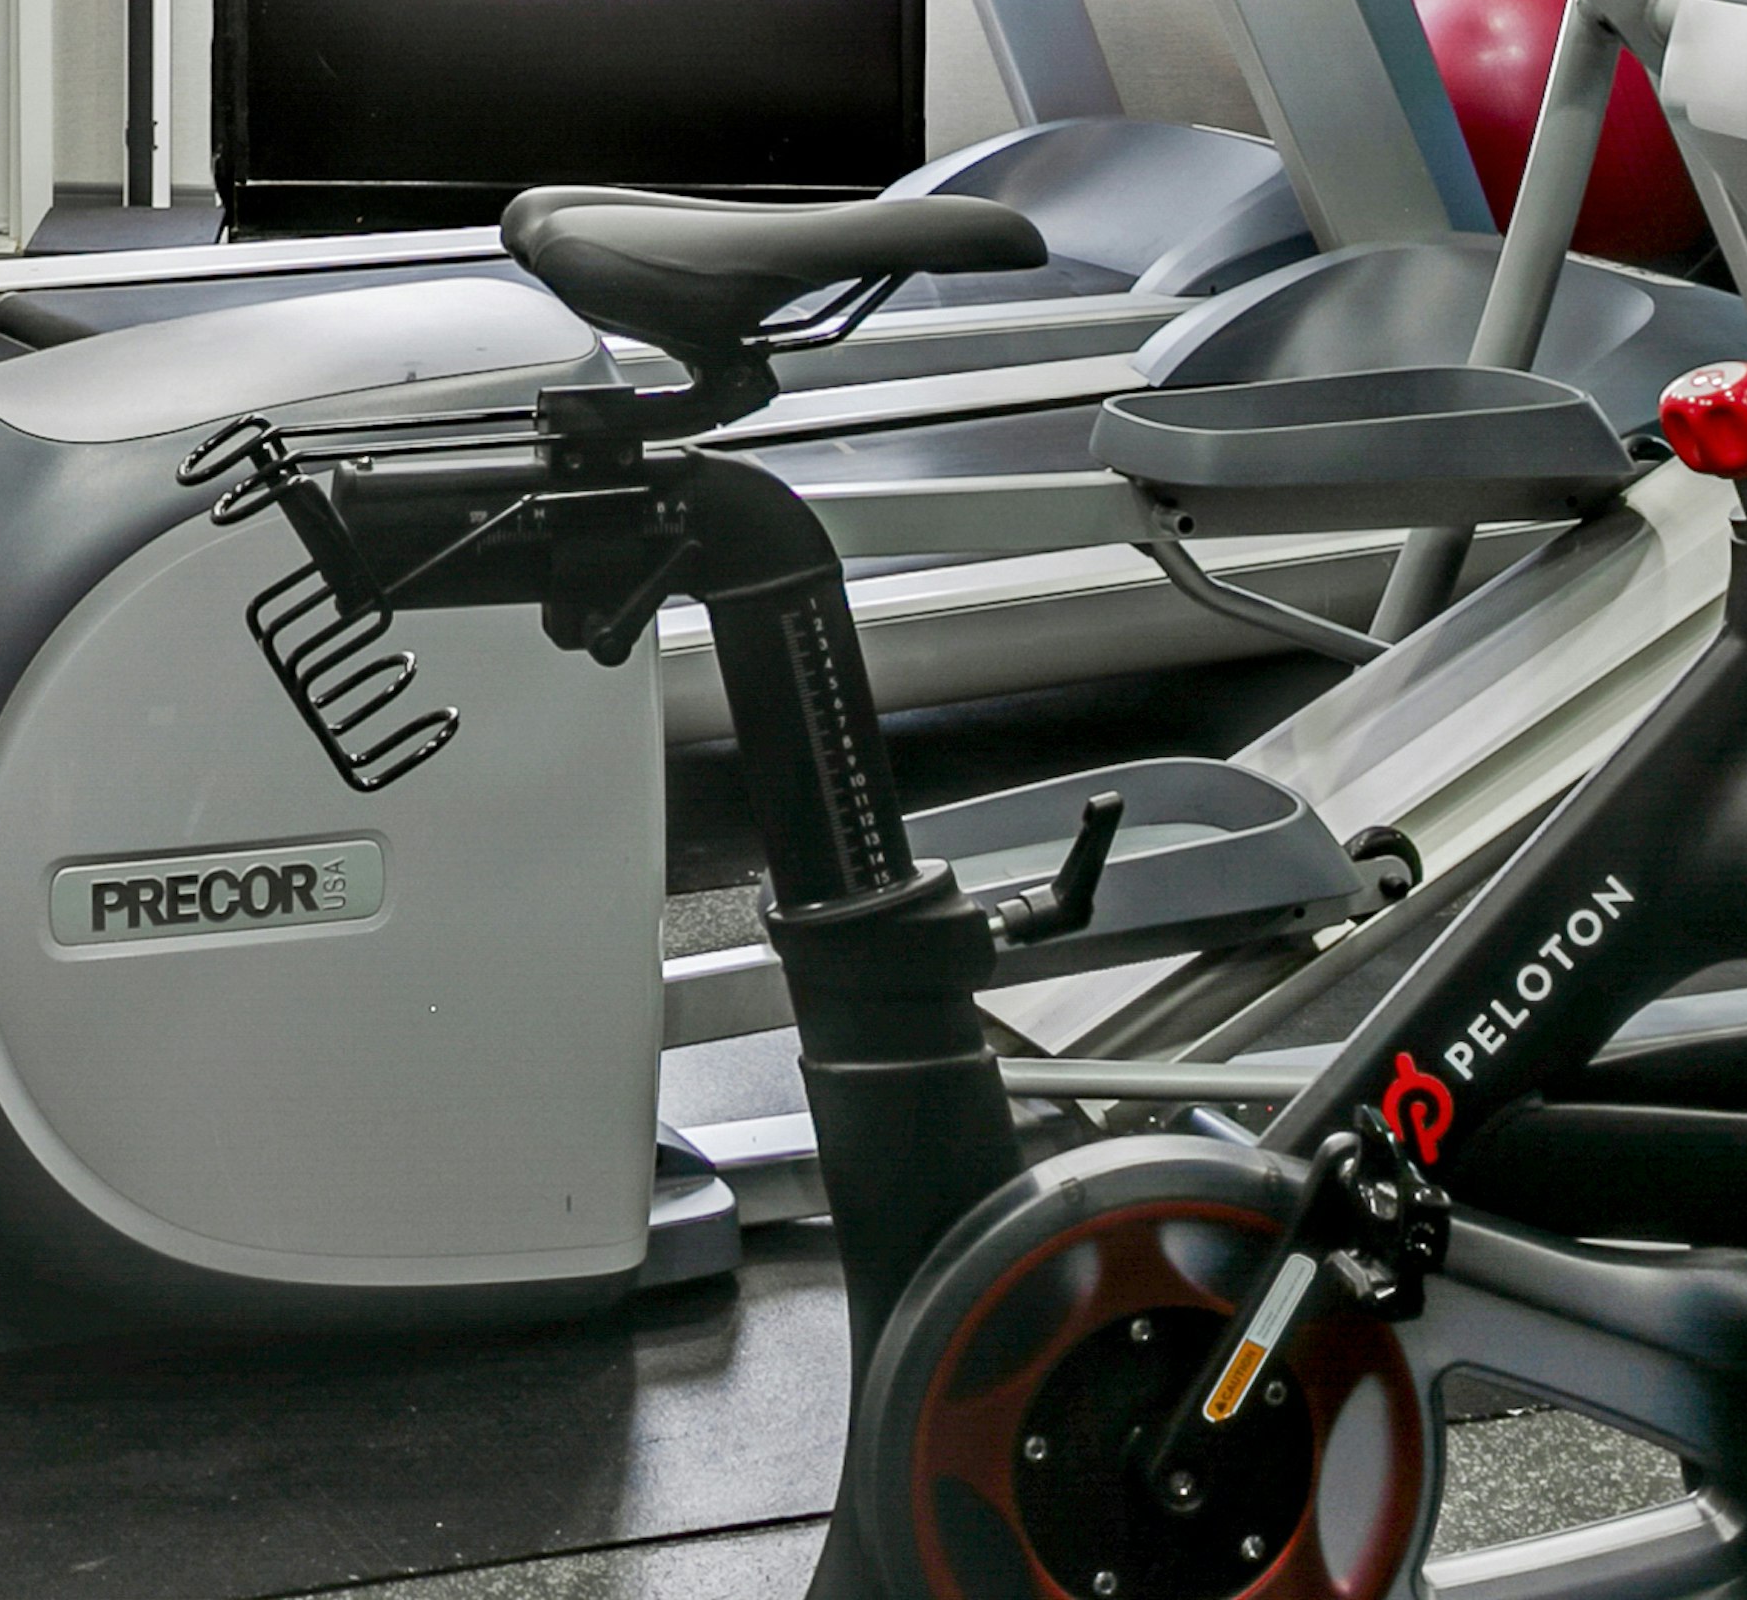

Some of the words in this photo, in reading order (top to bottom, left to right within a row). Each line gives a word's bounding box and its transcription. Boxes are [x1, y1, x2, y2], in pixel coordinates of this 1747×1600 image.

[814, 617, 823, 631] 2
[818, 637, 828, 651] 3
[850, 772, 866, 788] 10
[854, 792, 870, 808] 11
[859, 811, 875, 827] 12
[864, 831, 881, 846] 13
[868, 851, 886, 866] 14
[874, 870, 890, 885] 15
[91, 862, 321, 932] PRECOR
[321, 856, 347, 911] USA
[1444, 874, 1635, 1081] PELOTON
[1222, 1349, 1258, 1399] CAUTION
